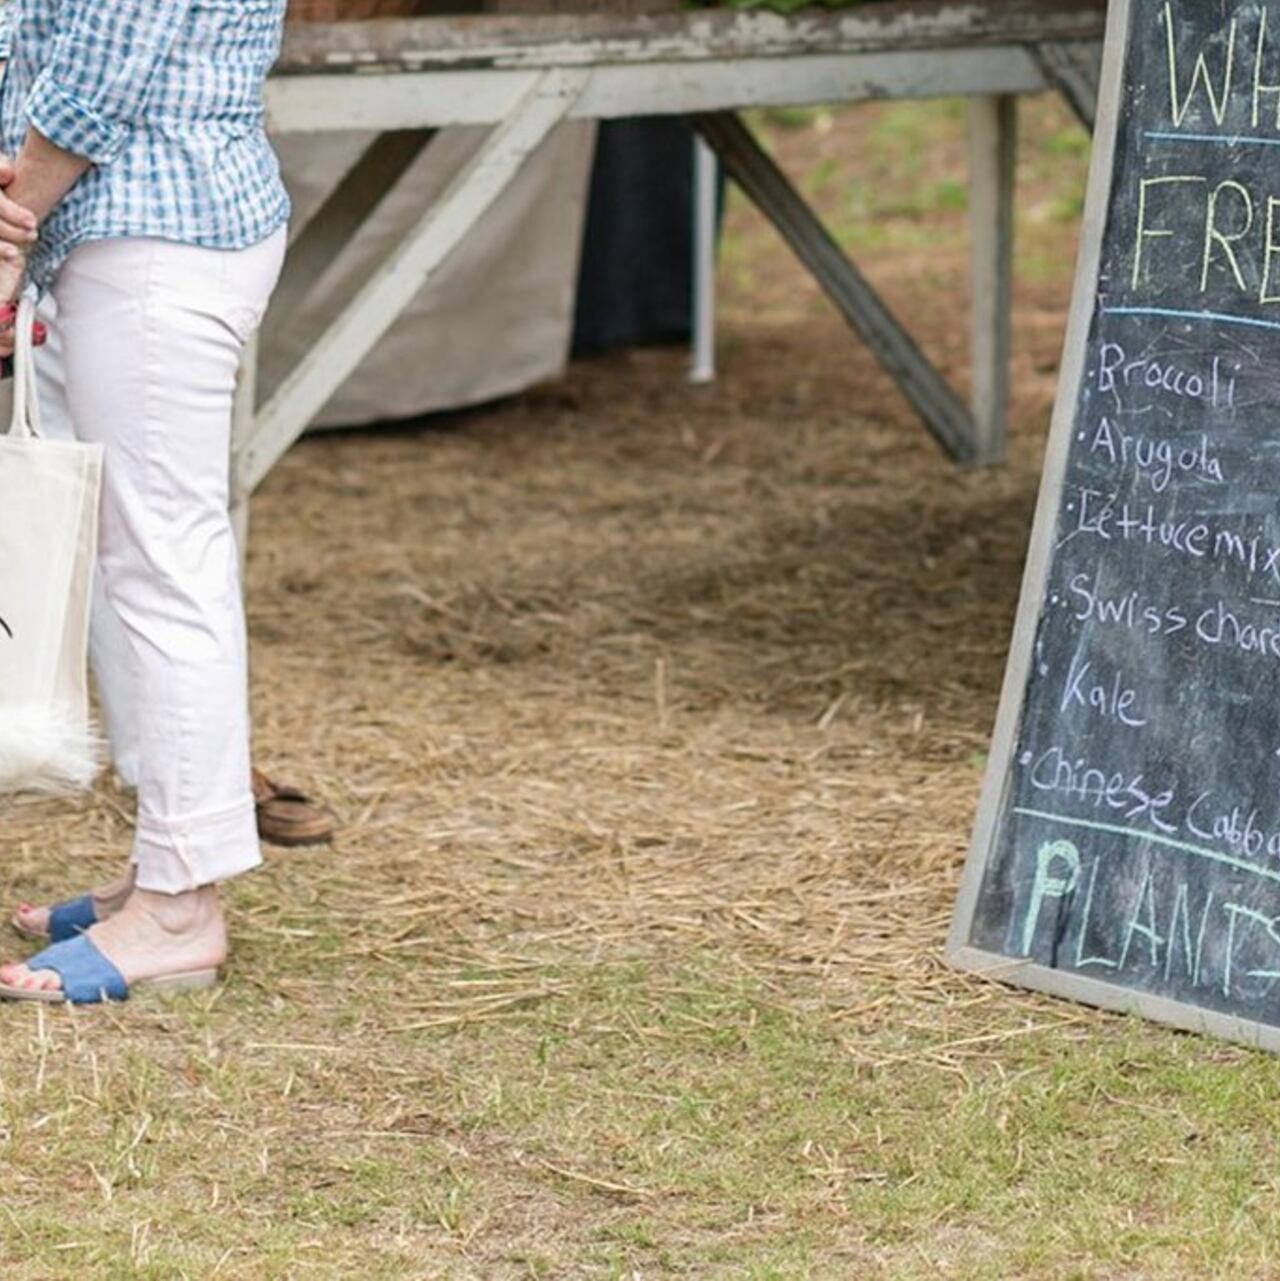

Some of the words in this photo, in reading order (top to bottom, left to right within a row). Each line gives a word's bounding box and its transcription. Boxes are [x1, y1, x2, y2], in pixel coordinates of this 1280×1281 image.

[1097, 344, 1241, 407] Broccoli
[1070, 573, 1187, 635] Swiss
[1061, 662, 1146, 725] Kale
[1031, 746, 1176, 832] Chinese
